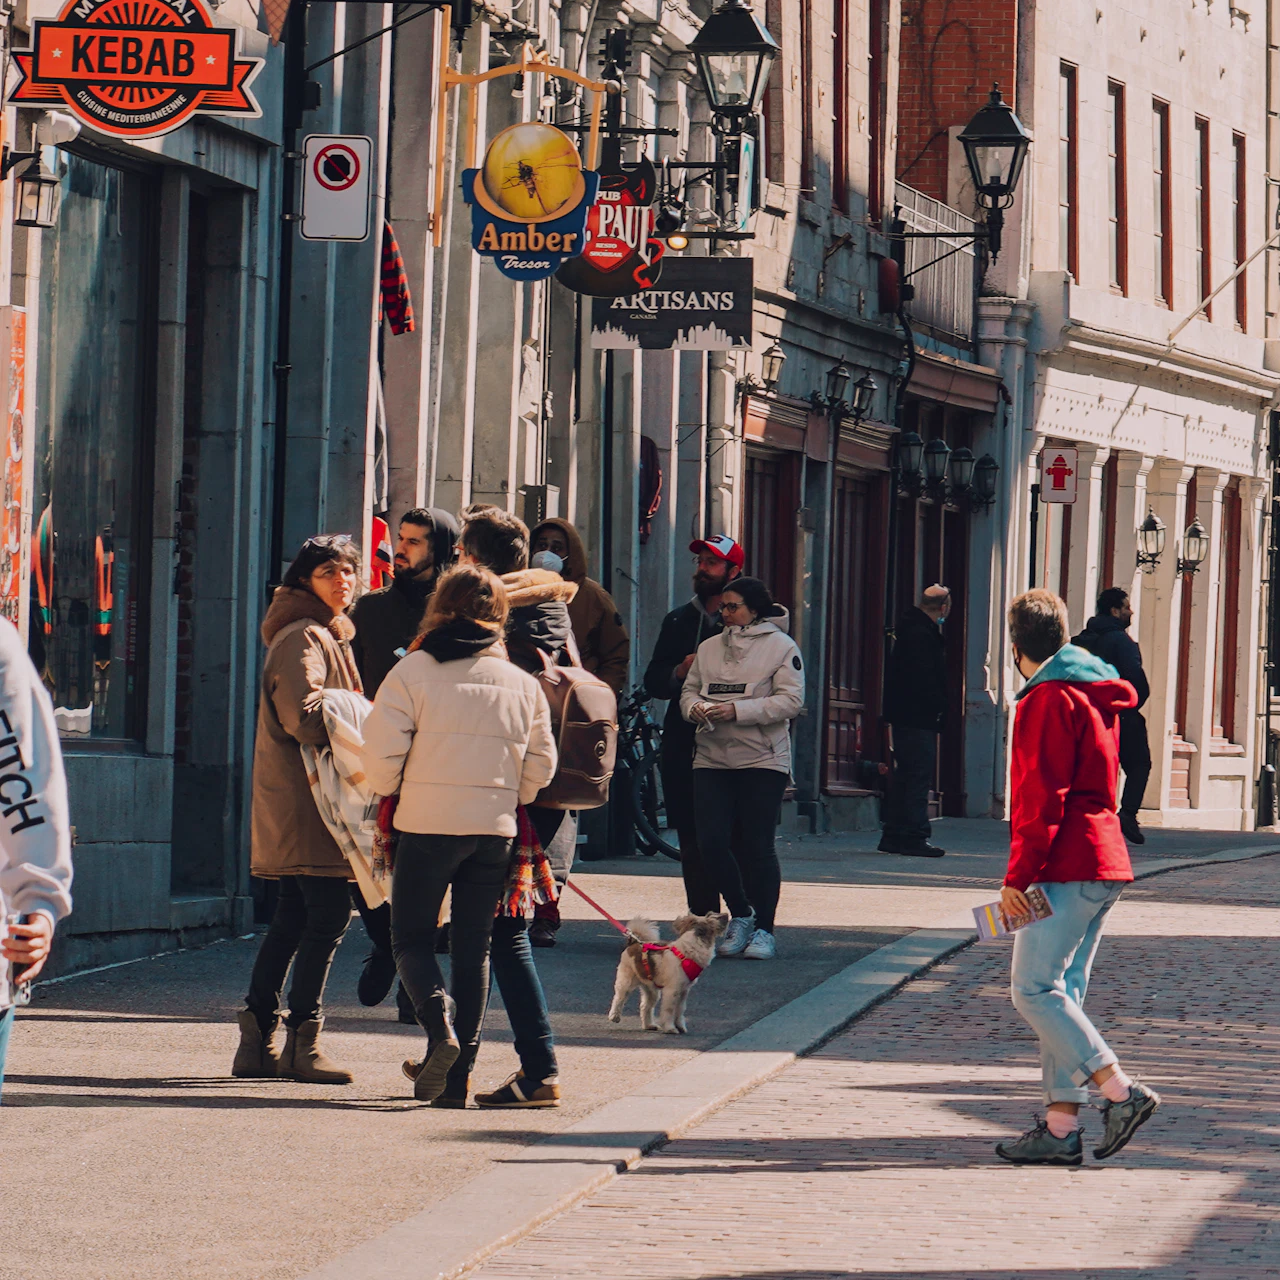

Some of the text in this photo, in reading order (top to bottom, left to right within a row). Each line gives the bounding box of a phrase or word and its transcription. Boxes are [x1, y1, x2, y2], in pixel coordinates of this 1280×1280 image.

[71, 34, 195, 77] KEBAB
[77, 90, 188, 124] CUISINE MEDITERRANEENNE
[596, 191, 621, 201] PUB
[478, 222, 577, 252] Amber
[597, 204, 652, 267] PAUL
[500, 254, 551, 269] Tresor
[610, 291, 734, 314] ARTISANS
